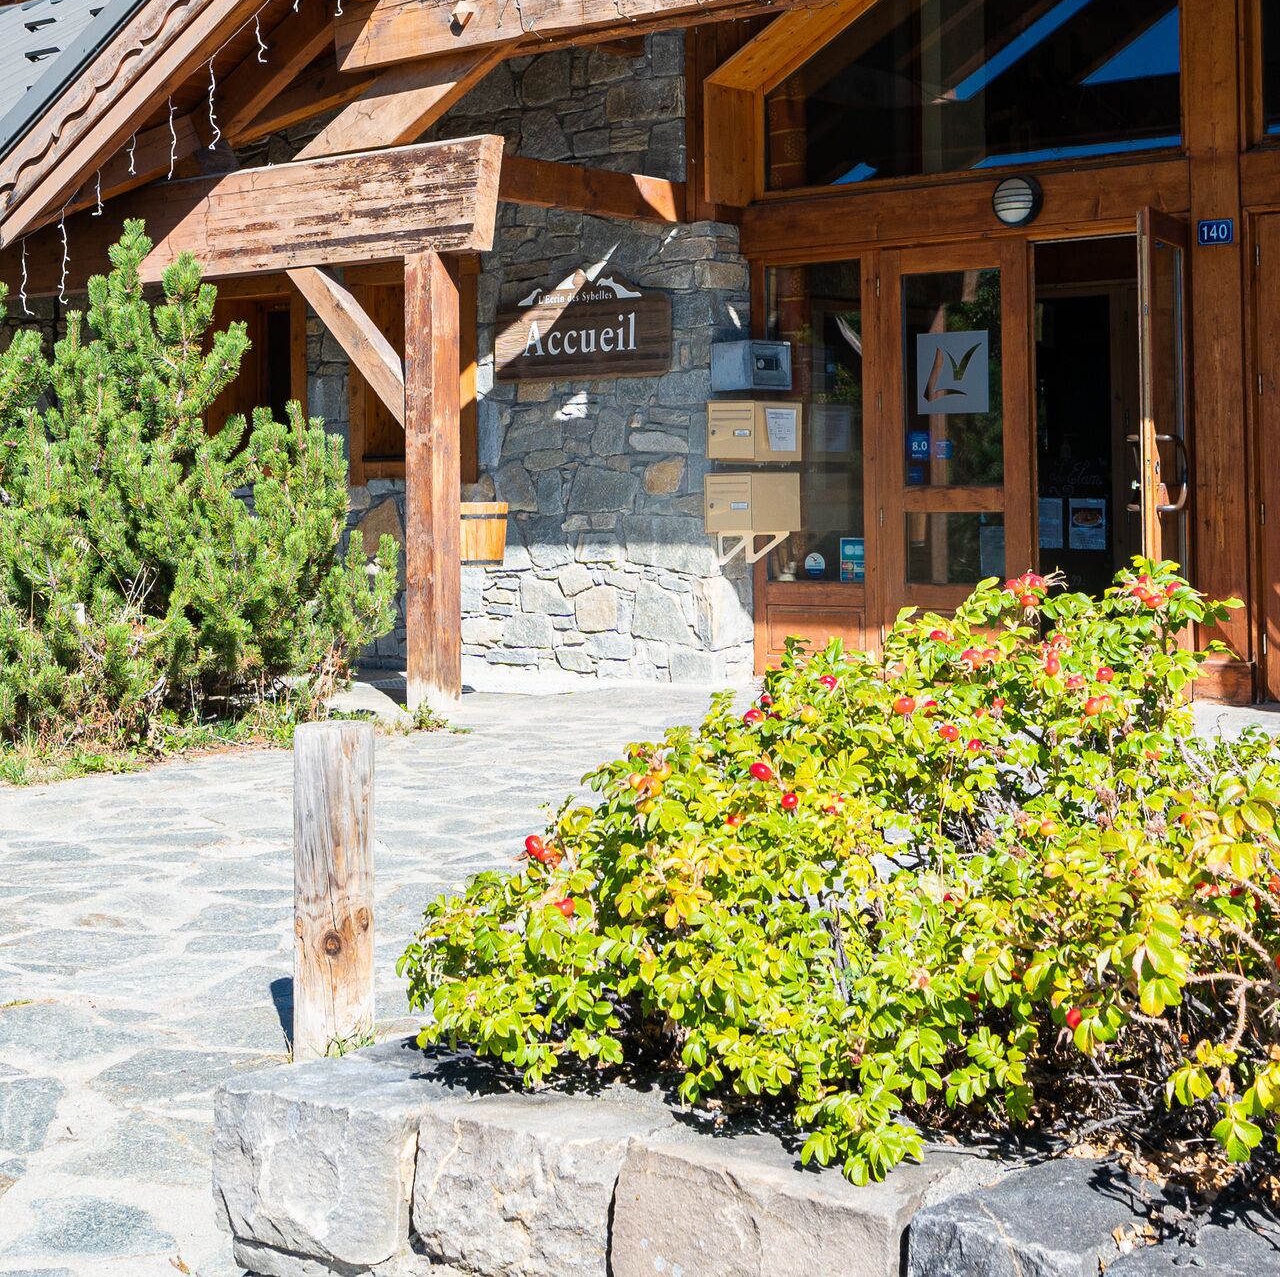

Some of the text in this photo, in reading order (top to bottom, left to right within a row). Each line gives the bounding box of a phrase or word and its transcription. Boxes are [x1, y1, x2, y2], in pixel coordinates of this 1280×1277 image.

[1202, 224, 1228, 240] 140
[567, 292, 580, 303] des
[581, 290, 612, 304] Sybelles
[522, 311, 638, 357] Accueil
[911, 441, 928, 451] 8.0
